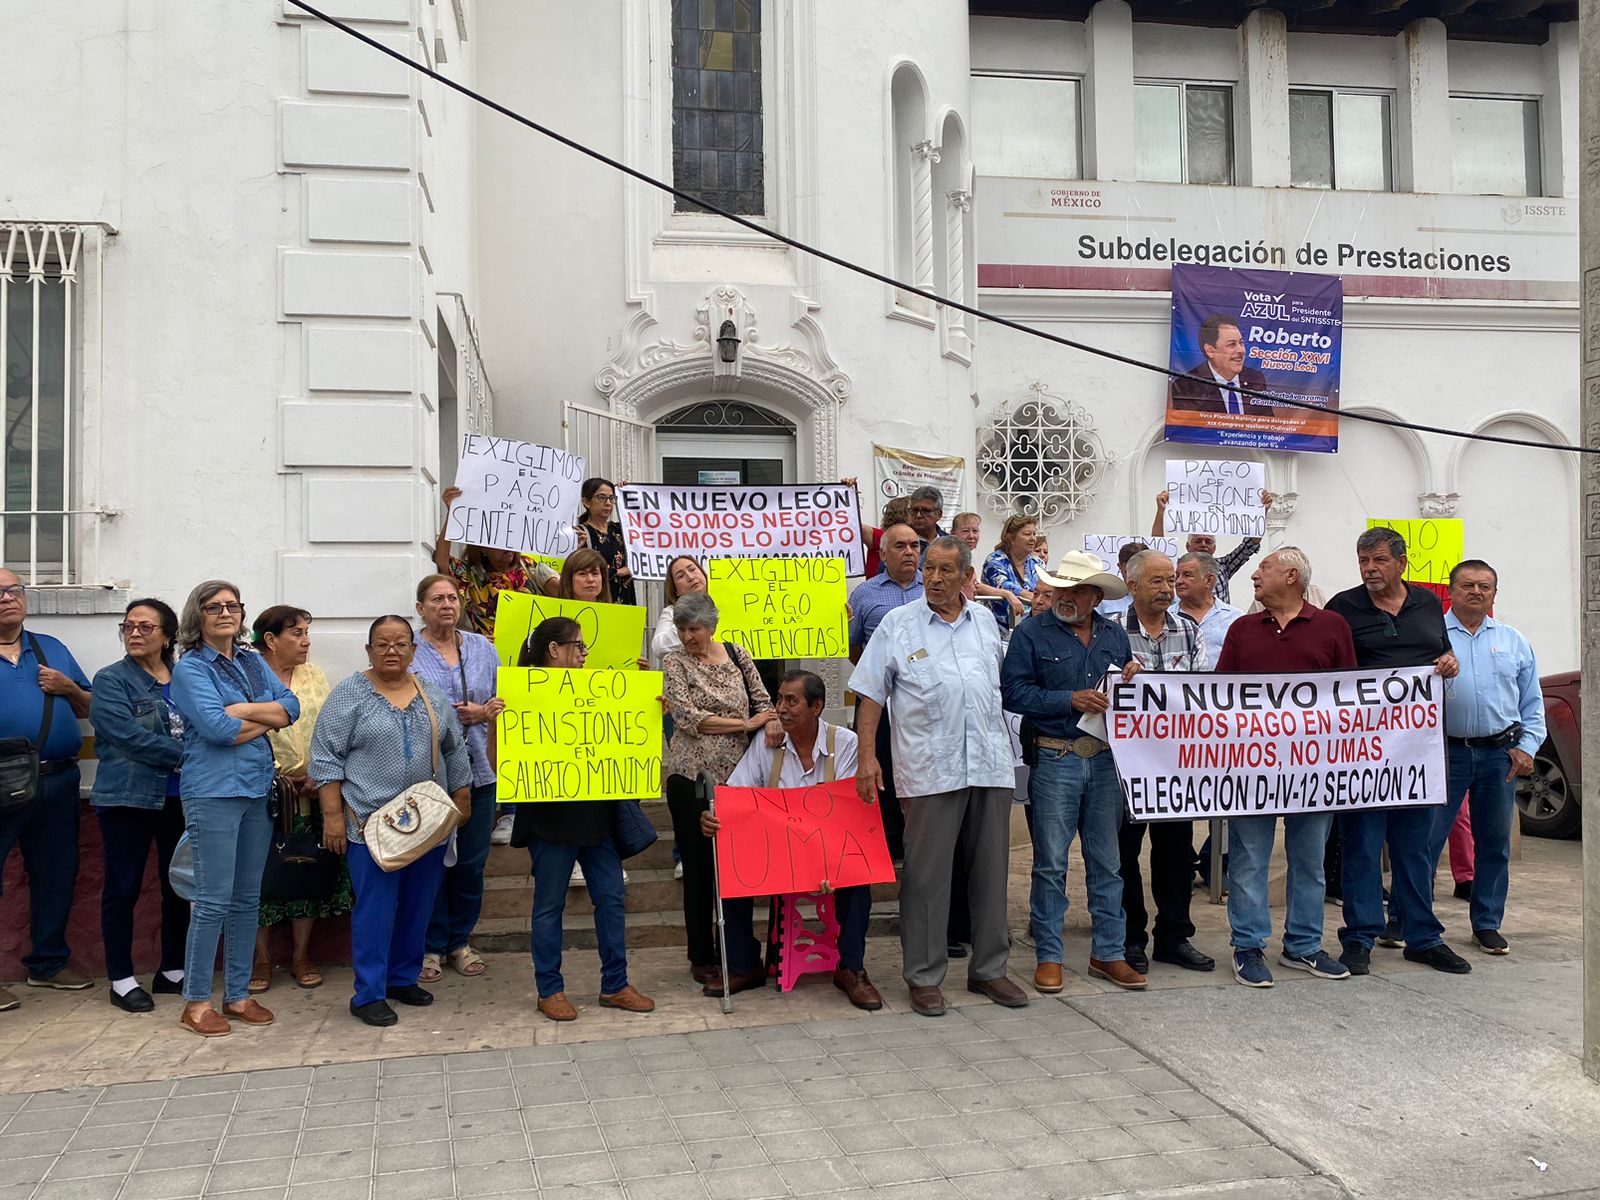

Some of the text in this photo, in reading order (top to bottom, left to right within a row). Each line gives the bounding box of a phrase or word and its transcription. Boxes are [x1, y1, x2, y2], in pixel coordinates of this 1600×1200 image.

[1050, 189, 1090, 197] GOBIERNO
[1051, 196, 1101, 208] MÉXICO
[1525, 205, 1566, 217] ISSSTE
[1078, 234, 1511, 272] Subdelegación de Prestaciones
[1244, 291, 1271, 302] Vota
[1240, 302, 1290, 321] AZUL
[1292, 307, 1332, 317] Presidente
[1249, 326, 1332, 349] Roberto
[1249, 347, 1331, 364] Sección XXVI
[1261, 359, 1318, 373] Nuevo León
[1263, 434, 1285, 442] trabajo
[518, 468, 538, 478] EL
[1184, 460, 1251, 478] PAGO
[485, 473, 560, 509] PAGO
[623, 486, 850, 512] EN NUEVO LEÓN
[1167, 482, 1265, 508] PENSIONES
[501, 502, 543, 514] DE LAS
[1208, 505, 1225, 513] EN
[628, 510, 849, 529] NO SOMOS NECIOS
[1168, 509, 1266, 537] SALARIO MINIMO
[628, 526, 855, 549] PEDIMOS LO JUSTO
[708, 558, 841, 583] EXIGIMOS
[768, 582, 787, 592] EL
[743, 593, 811, 616] PAGO
[763, 615, 803, 625] DE LAS
[528, 668, 627, 699] PAGO
[1112, 670, 1434, 712] EN NUEVO LEÓN
[574, 697, 595, 707] DE
[502, 709, 649, 746] PENSIONES
[1114, 703, 1438, 740] EXIGIMOS PAGO EN SALARIOS
[574, 746, 596, 759] EN
[1178, 736, 1383, 771] MINIMOS, NO UMAS
[499, 756, 663, 800] SALARIO MINIMO
[1255, 772, 1319, 810] D-IV-12
[1323, 760, 1402, 806] SECCIÓN
[1409, 763, 1427, 799] 21
[751, 787, 833, 819] NO
